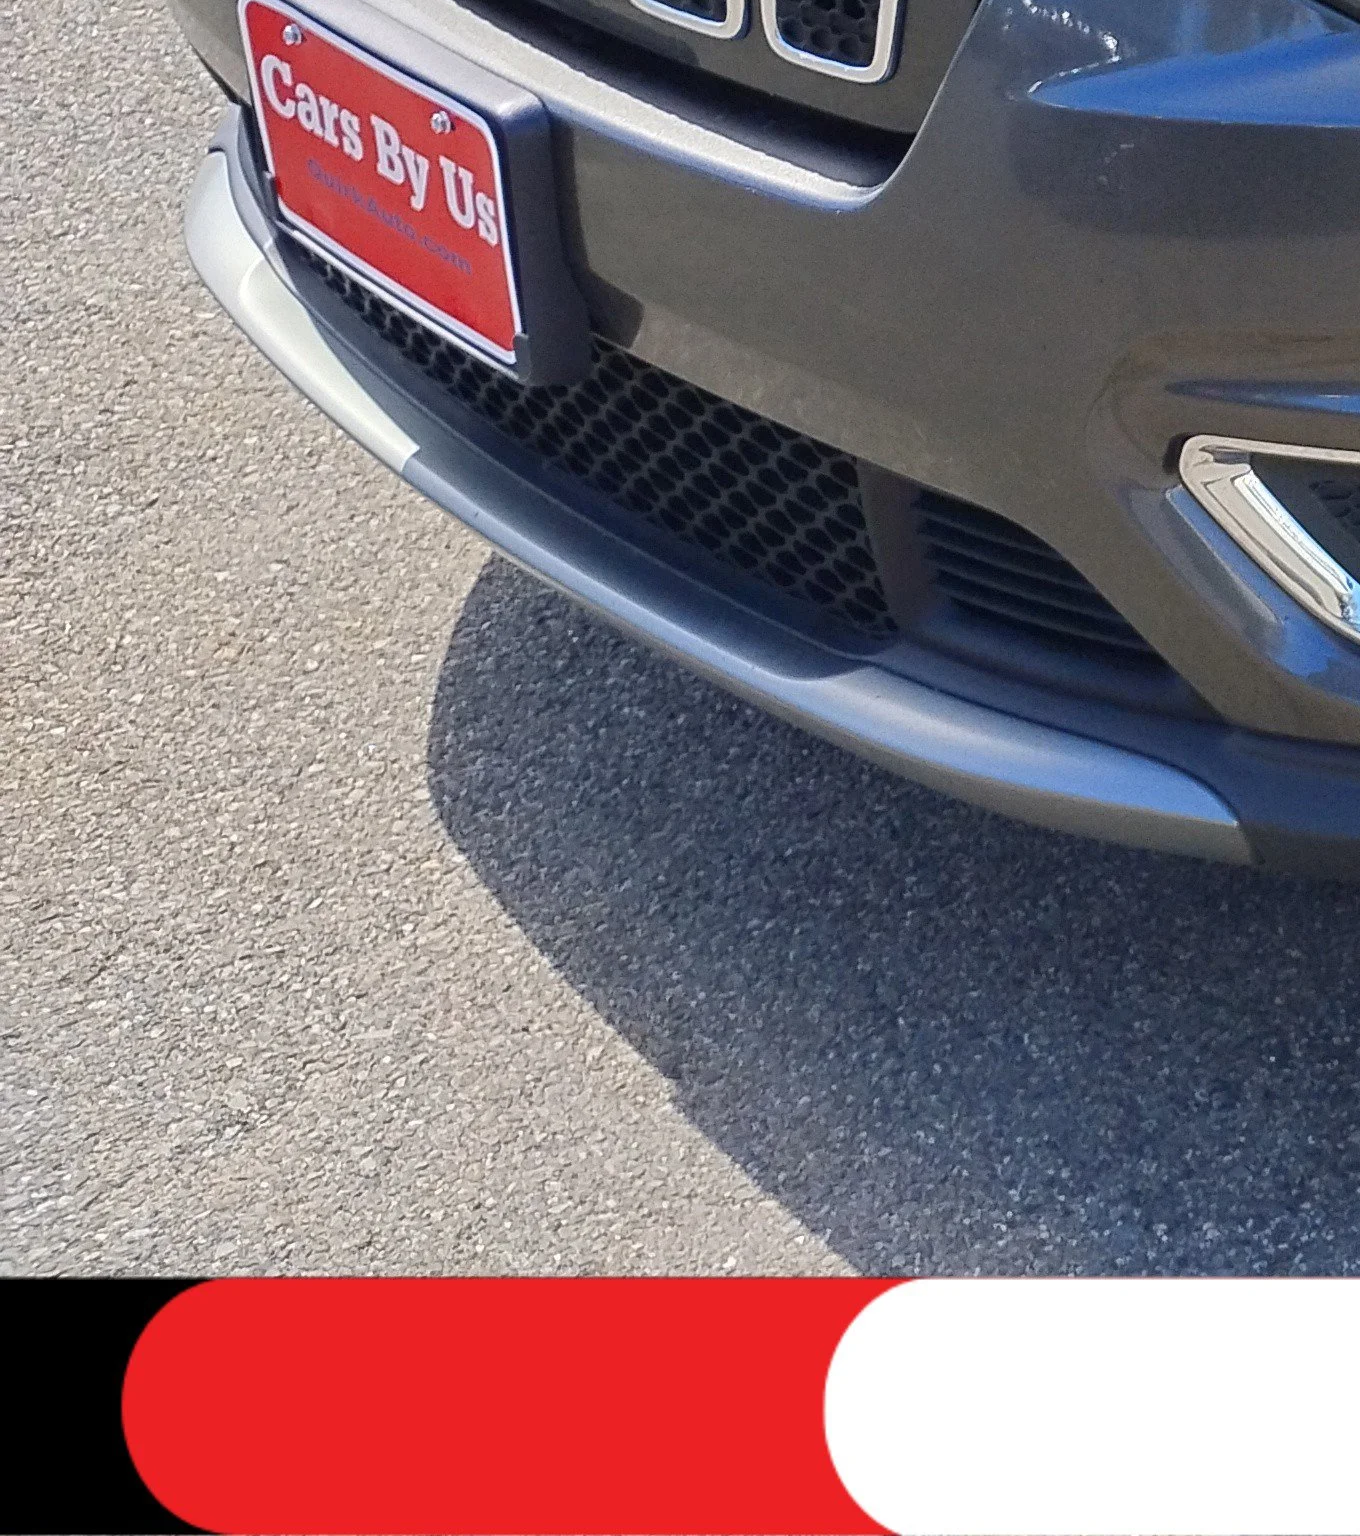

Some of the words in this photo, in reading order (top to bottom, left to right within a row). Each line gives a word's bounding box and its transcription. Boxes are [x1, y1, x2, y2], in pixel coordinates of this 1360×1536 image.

[260, 54, 364, 161] Cars
[369, 113, 430, 213] By
[438, 154, 499, 248] Us
